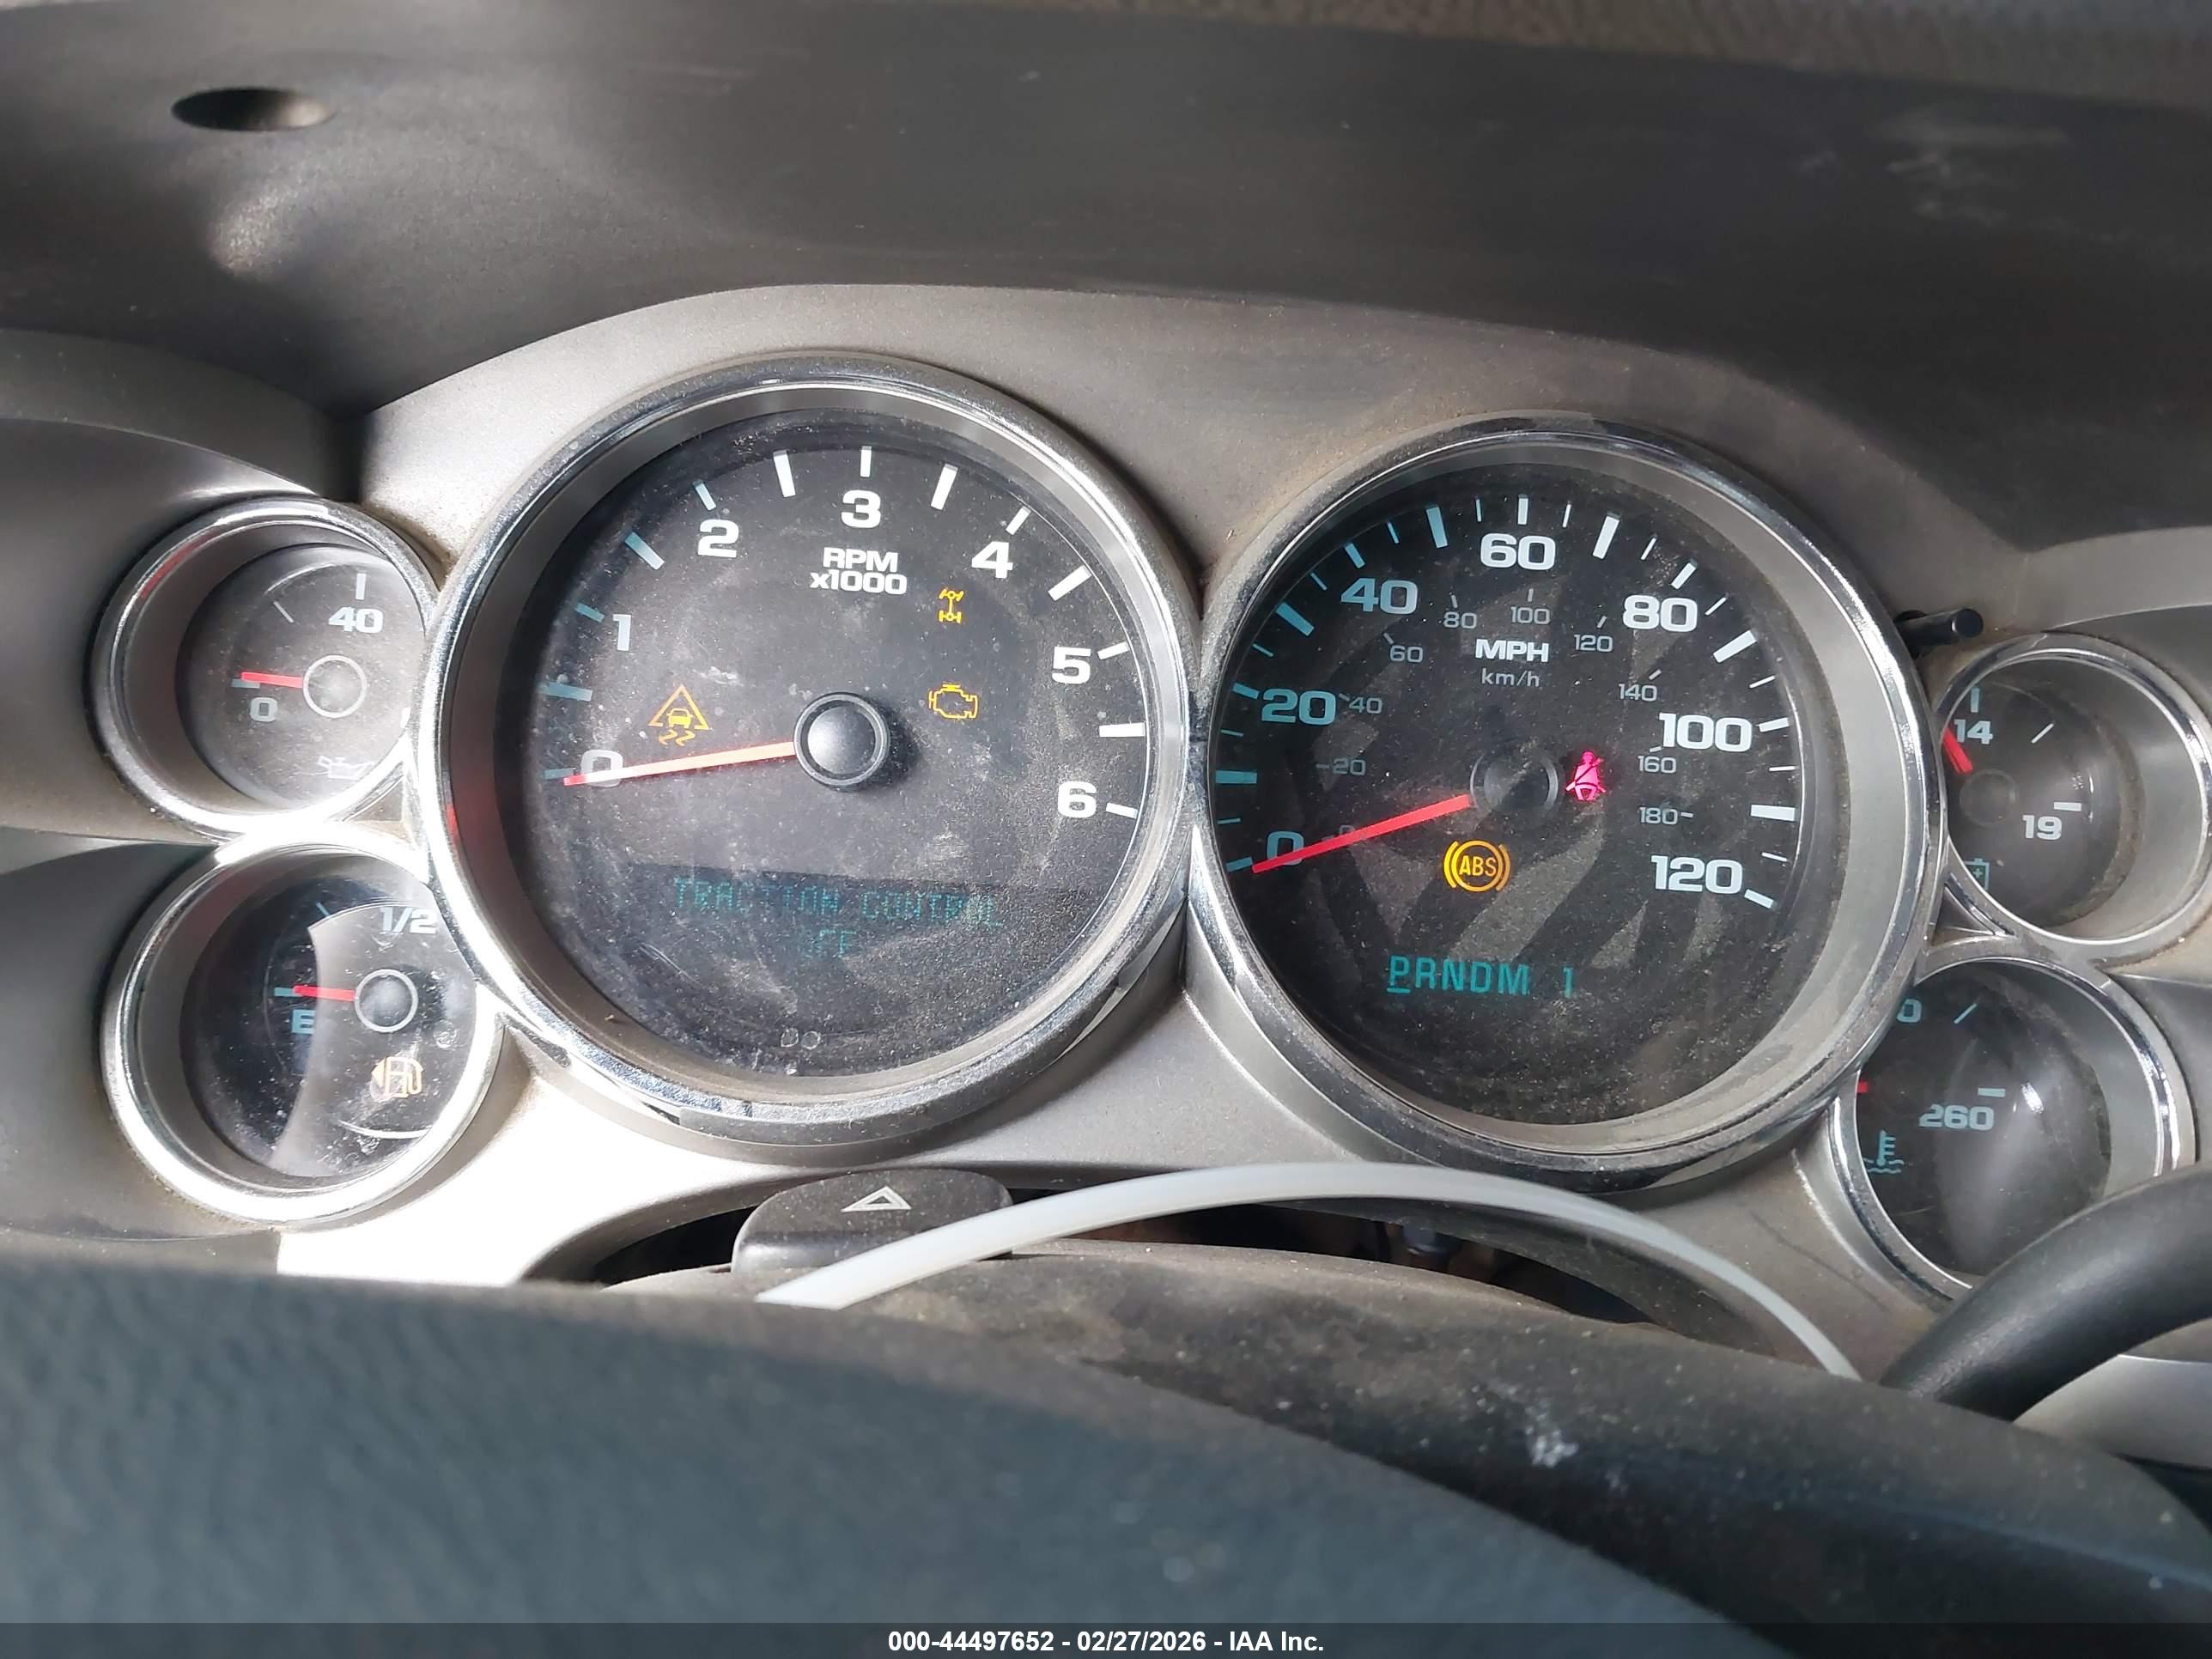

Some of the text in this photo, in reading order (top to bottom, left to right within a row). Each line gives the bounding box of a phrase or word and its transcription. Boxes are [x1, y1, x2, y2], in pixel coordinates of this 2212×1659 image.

[842, 490, 881, 528] 3
[698, 520, 739, 558] 2
[1480, 533, 1556, 570] 60
[823, 548, 898, 572] RPM
[972, 541, 1013, 579] 4
[811, 570, 907, 595] x1000
[1341, 579, 1418, 615] 40
[328, 608, 384, 634] 40
[1443, 611, 1478, 629] 80
[1511, 606, 1551, 625] 100
[1623, 595, 1698, 633] 80
[613, 614, 631, 651] 1
[1575, 635, 1614, 653] 120
[1390, 645, 1424, 663] 60
[1475, 639, 1549, 663] MPH
[1052, 647, 1091, 684] 5
[1481, 669, 1540, 687] km/h
[1349, 697, 1383, 714] 40
[1619, 684, 1658, 702] 140
[250, 696, 277, 722] 0
[1261, 689, 1336, 726] 20
[1659, 714, 1753, 753] 100
[1954, 719, 1993, 744] 14
[580, 749, 623, 787] 0
[1332, 758, 1366, 775] 20
[1638, 754, 1676, 775] 160
[1057, 781, 1097, 819] 6
[1639, 806, 1679, 826] 180
[2022, 815, 2062, 841] 19
[1267, 831, 1304, 866] 0
[1459, 855, 1497, 877] ABS
[1650, 855, 1743, 895] 120
[380, 907, 437, 934] 1/2
[861, 890, 1004, 929] CONTROL
[292, 1010, 316, 1034] E
[1919, 1105, 1994, 1131] 260
